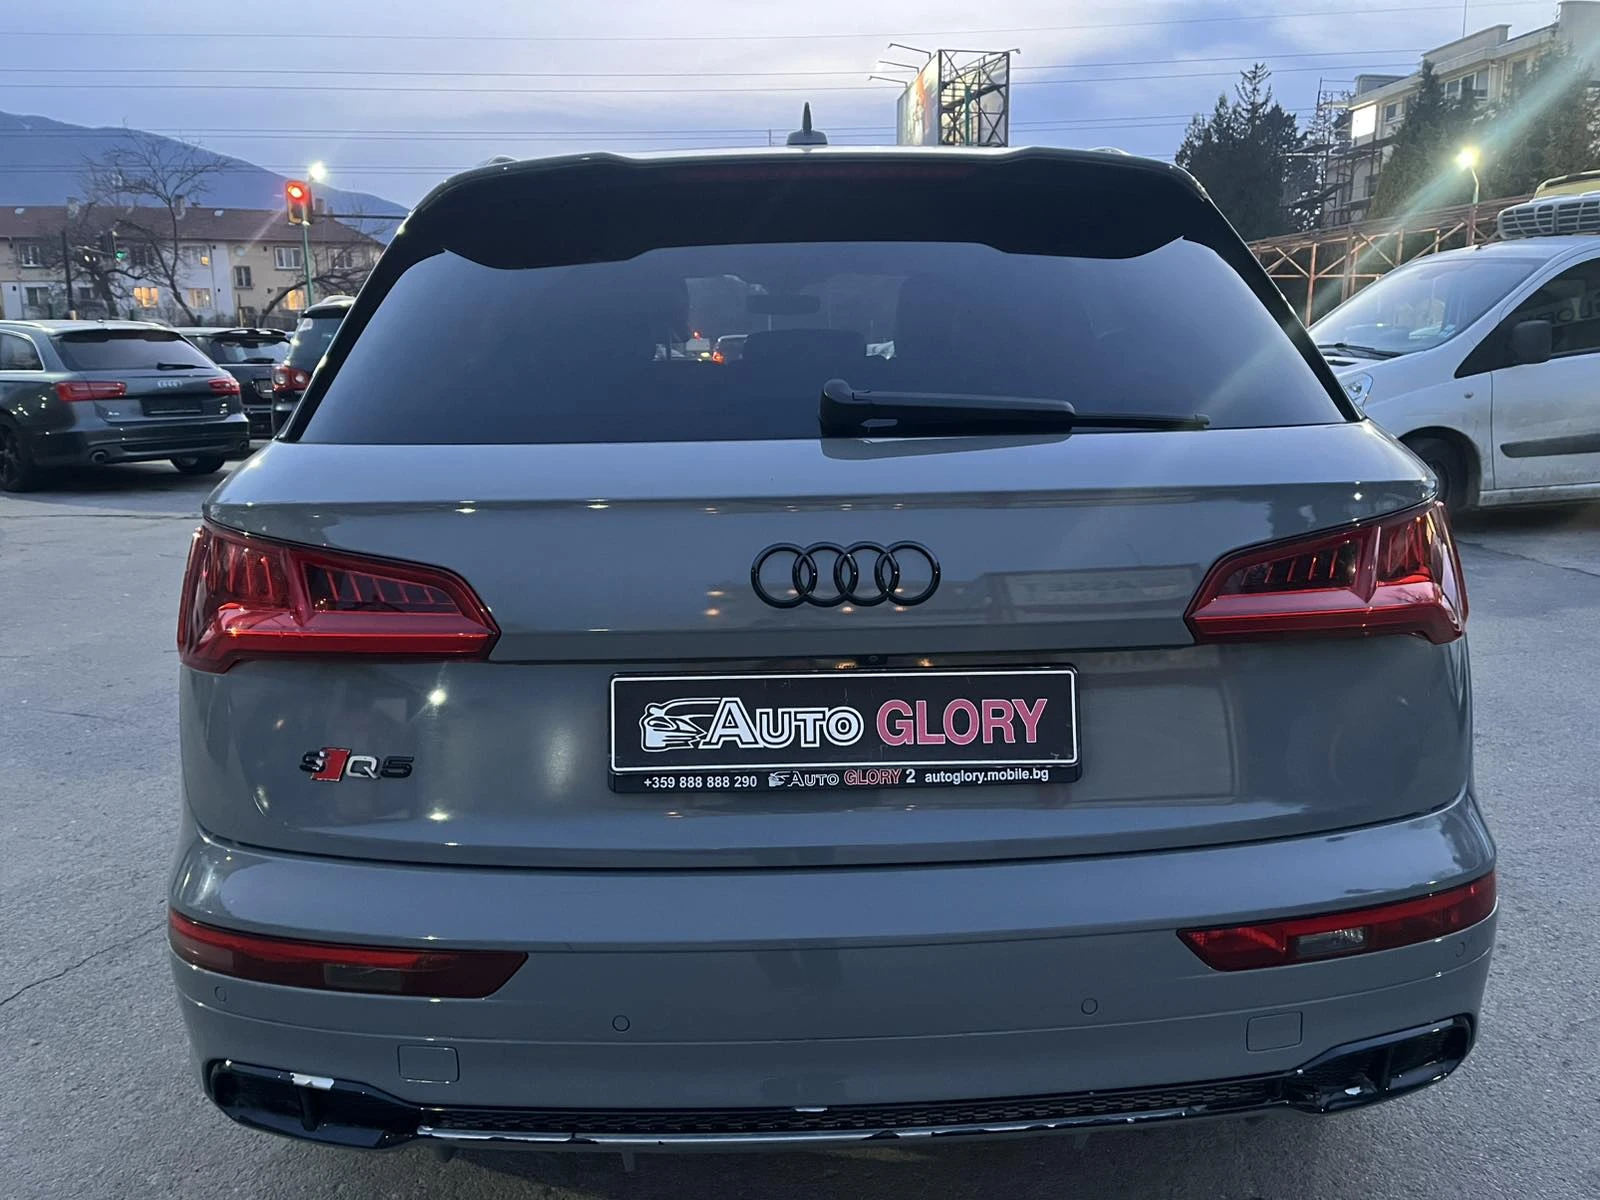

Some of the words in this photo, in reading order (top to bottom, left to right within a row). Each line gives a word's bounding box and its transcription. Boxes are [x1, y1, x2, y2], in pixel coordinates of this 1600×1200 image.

[876, 698, 1048, 746] GLORY
[643, 776, 676, 788] +359
[679, 776, 703, 788] 888
[706, 776, 730, 788] 888
[734, 775, 758, 787] 290
[843, 768, 901, 786] GLORY
[905, 769, 916, 783] 2
[924, 769, 1050, 785] autoglory.mobile.bg
